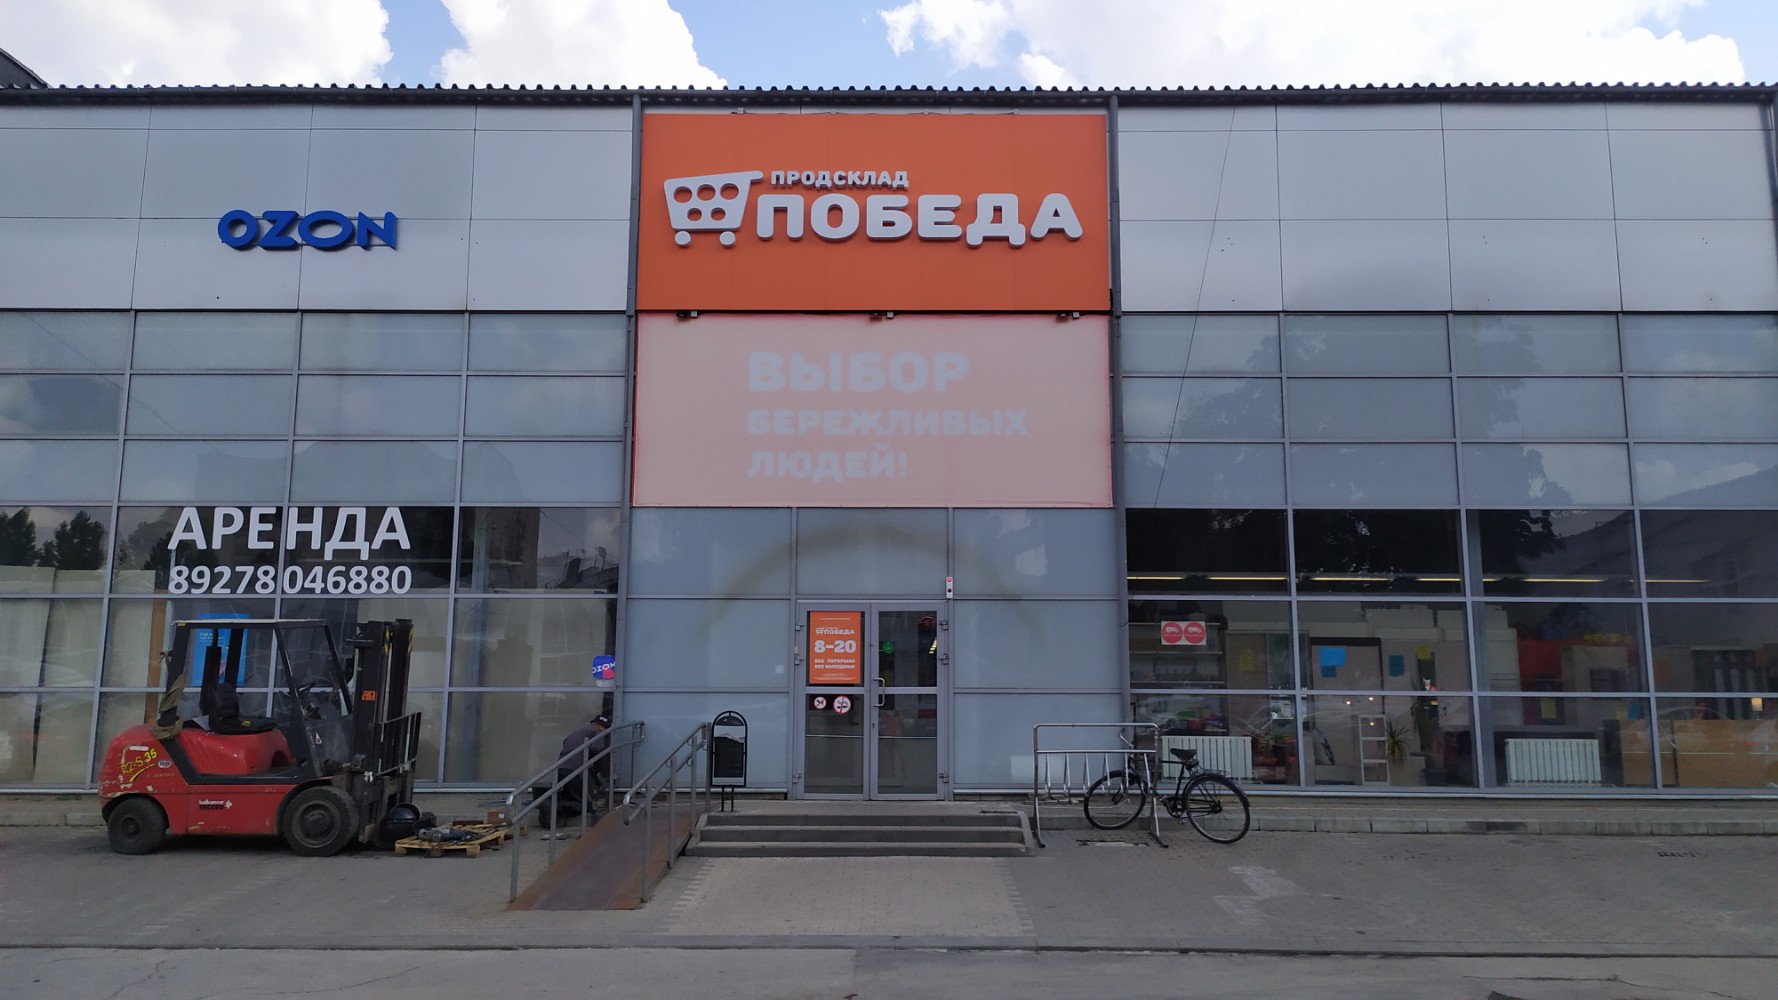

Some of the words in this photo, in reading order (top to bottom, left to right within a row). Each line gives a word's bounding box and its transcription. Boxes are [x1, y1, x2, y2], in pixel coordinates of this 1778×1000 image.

[771, 170, 910, 189] ПРОДСКЛАД
[217, 209, 398, 251] OZON
[756, 192, 1084, 249] ПОБЕДА
[746, 351, 971, 393] ВЫБОР
[746, 409, 1029, 437] БЕРЕЖЛИВЫХ
[746, 443, 909, 482] ЛЮДЕЙ!
[167, 506, 412, 561] АРЕНДА
[168, 565, 413, 595] 89278046880
